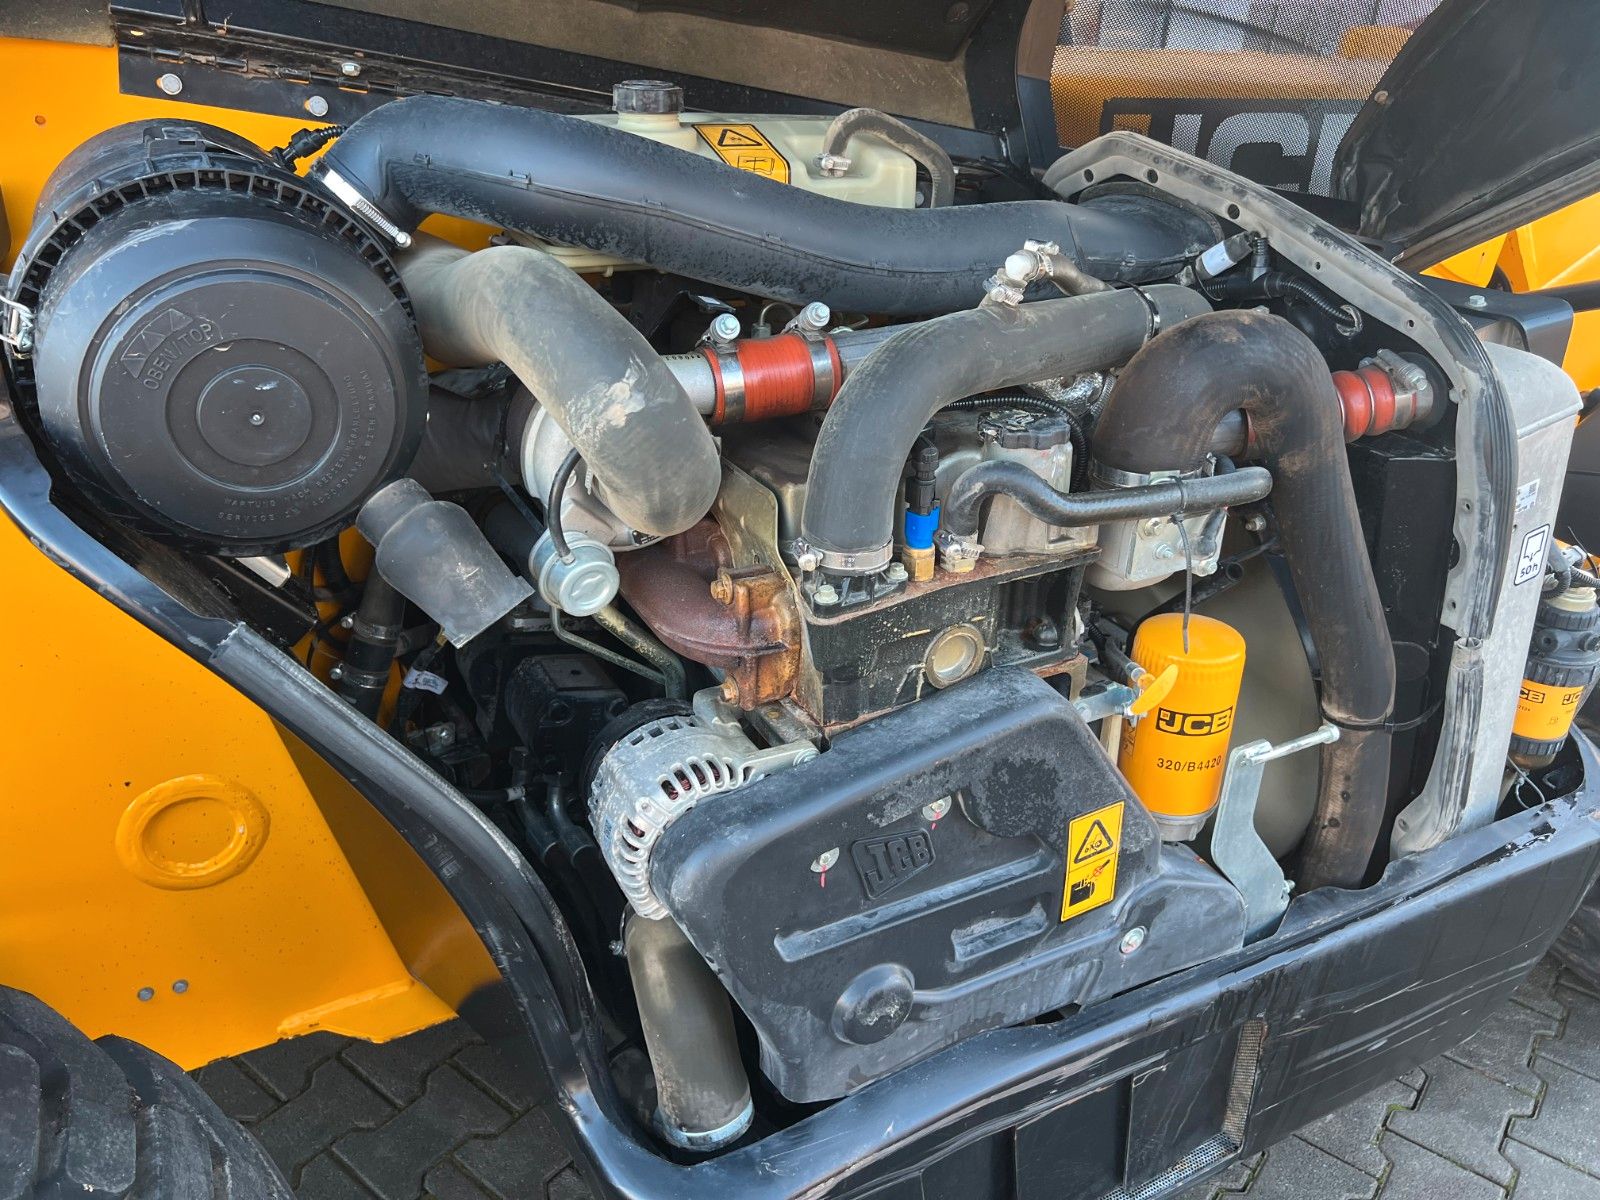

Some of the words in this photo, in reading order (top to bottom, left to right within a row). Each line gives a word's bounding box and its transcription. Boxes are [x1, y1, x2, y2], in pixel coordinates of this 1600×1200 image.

[143, 322, 212, 390] OBEN/TOP
[1156, 706, 1233, 737] JCB
[1156, 755, 1222, 772] 320/B4420
[859, 833, 933, 895] JCB
